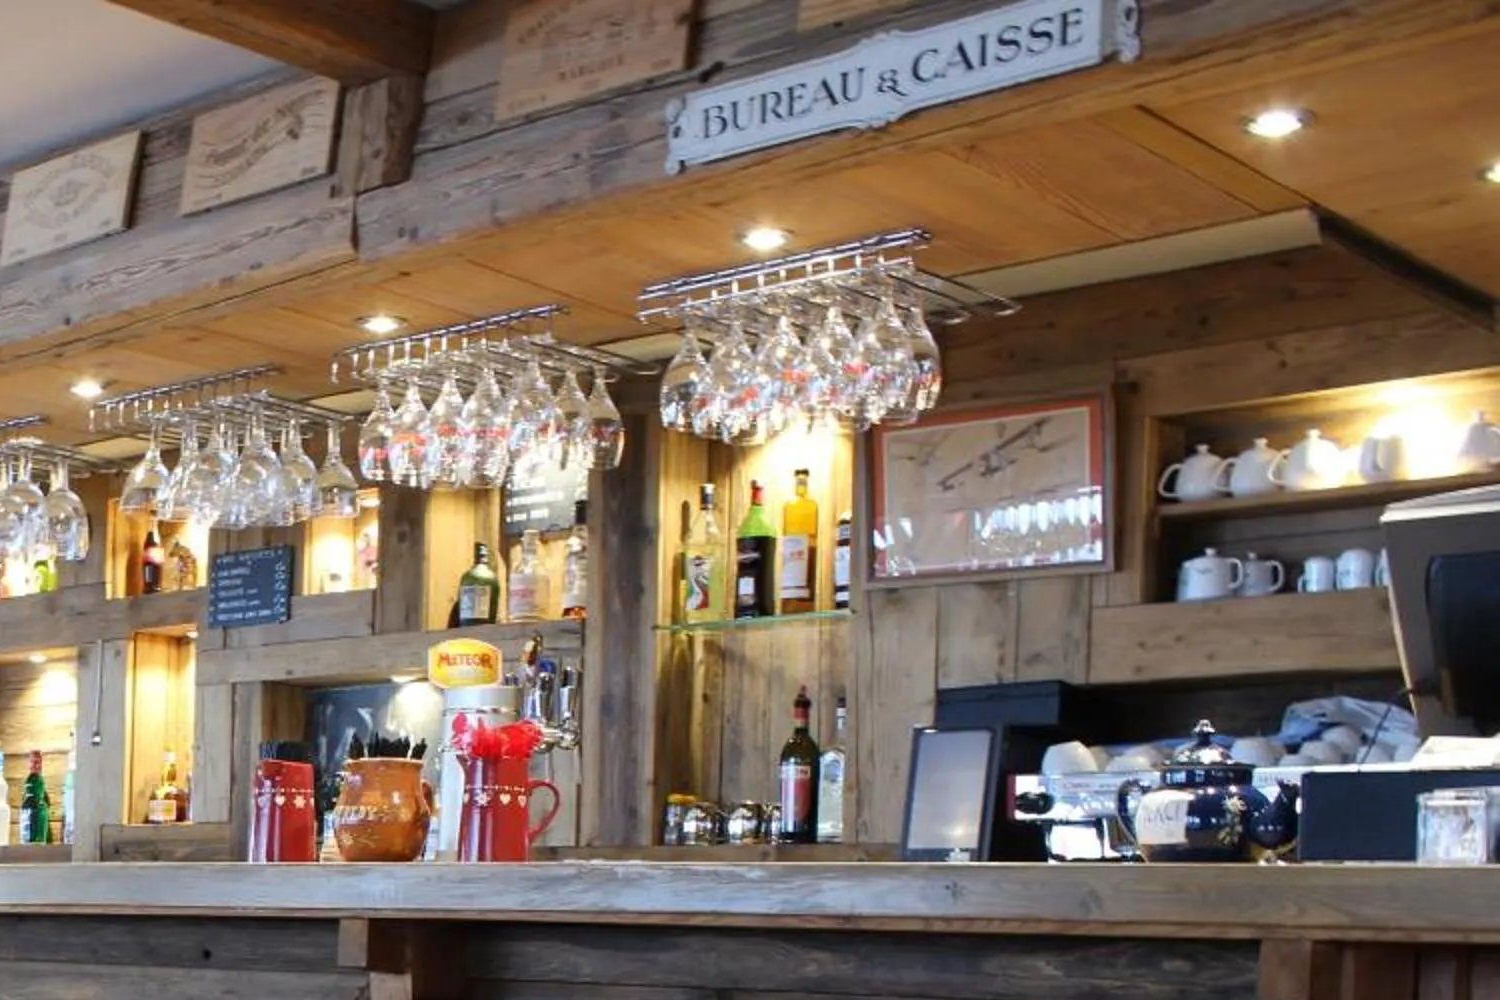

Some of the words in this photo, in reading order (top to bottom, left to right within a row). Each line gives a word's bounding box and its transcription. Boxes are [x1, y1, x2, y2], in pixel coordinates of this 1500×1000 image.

[702, 67, 865, 139] BUREAU
[876, 68, 907, 97] &
[911, 7, 1084, 83] CAISSE
[437, 652, 493, 670] METEOR
